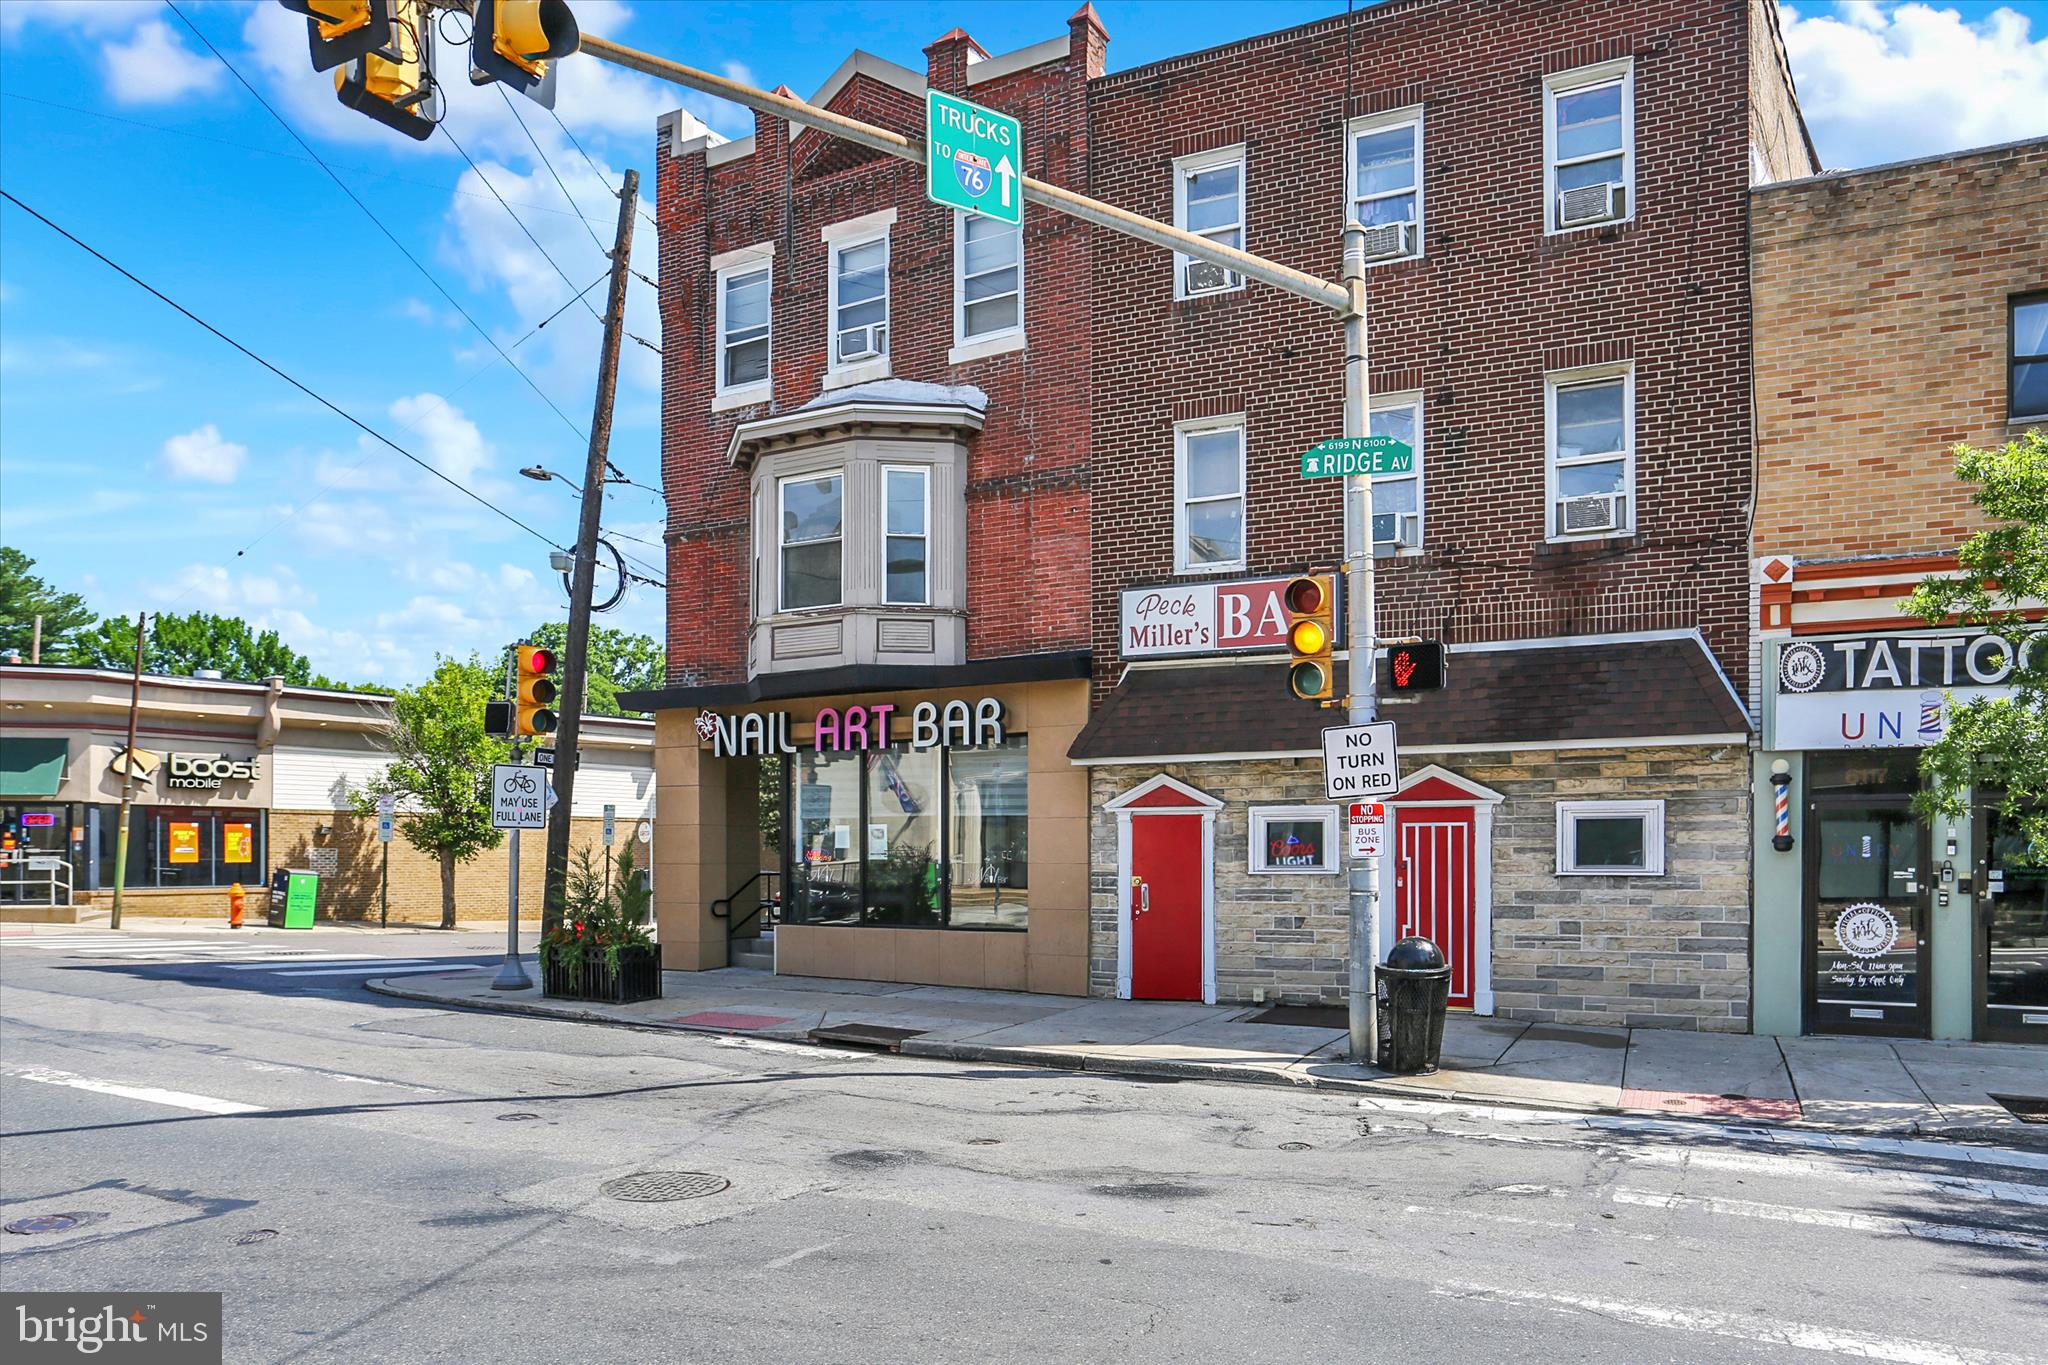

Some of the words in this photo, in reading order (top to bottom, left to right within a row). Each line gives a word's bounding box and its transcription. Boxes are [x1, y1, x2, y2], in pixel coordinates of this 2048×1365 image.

[937, 103, 1011, 146] TRUCKS
[934, 141, 951, 158] TO
[961, 165, 984, 190] 76
[1328, 441, 1350, 450] 6199
[1352, 440, 1361, 450] N
[1363, 439, 1386, 448] 6100
[1323, 452, 1383, 474] RIDGE
[1391, 456, 1409, 470] AV
[1135, 593, 1196, 620] Peck
[1219, 590, 1292, 640] BA
[1129, 621, 1210, 649] Miller's
[714, 711, 797, 757] NAIL
[815, 704, 895, 751] ART
[913, 697, 1003, 748] BAR
[1346, 732, 1372, 748] NO
[171, 753, 262, 779] boost
[539, 753, 552, 762] ONE
[1337, 752, 1385, 770] TURN
[169, 778, 221, 789] mobile
[1332, 776, 1356, 791] ON
[1362, 772, 1392, 788] RED
[501, 797, 518, 807] MAY
[521, 798, 538, 808] USE
[1360, 804, 1373, 815] NO
[496, 811, 516, 821] FULL
[520, 812, 542, 822] LANE
[1351, 815, 1384, 824] STOPPING
[1355, 836, 1380, 844] ZONE
